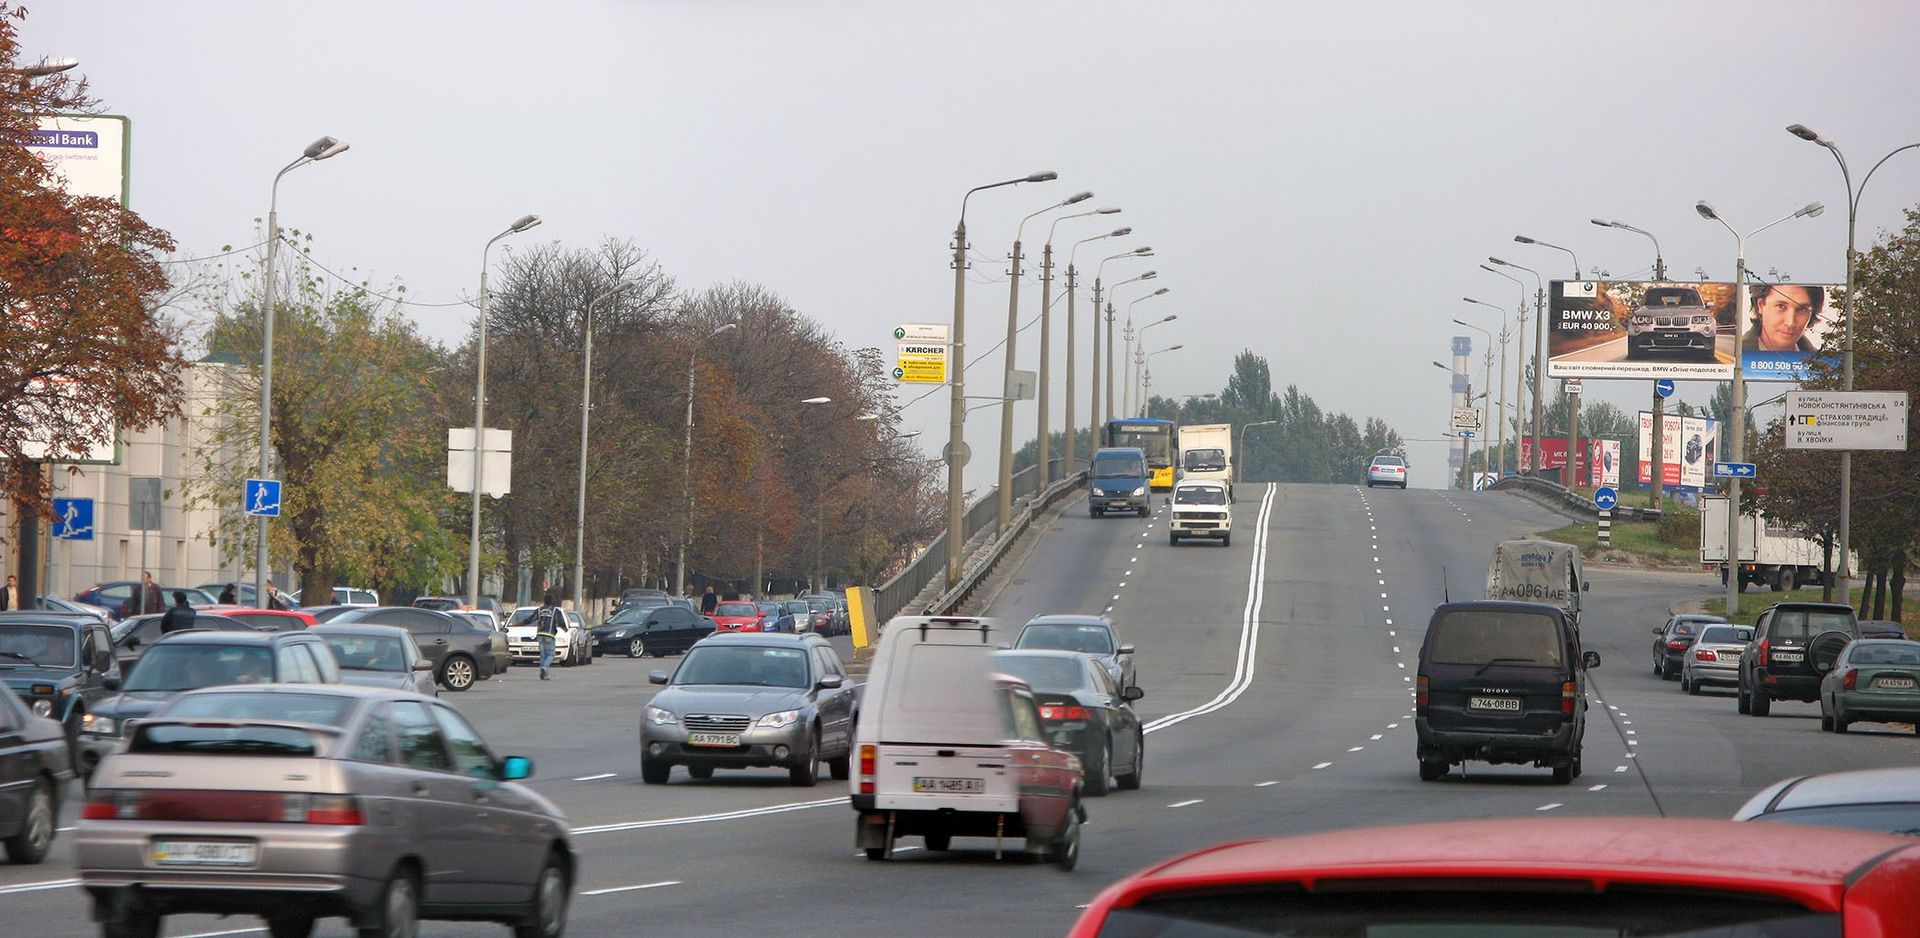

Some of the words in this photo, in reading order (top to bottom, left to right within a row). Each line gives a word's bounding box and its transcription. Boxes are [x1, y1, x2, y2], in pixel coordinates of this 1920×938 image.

[62, 134, 92, 145] Bank
[1562, 310, 1593, 320] BMW
[1595, 310, 1611, 320] X3
